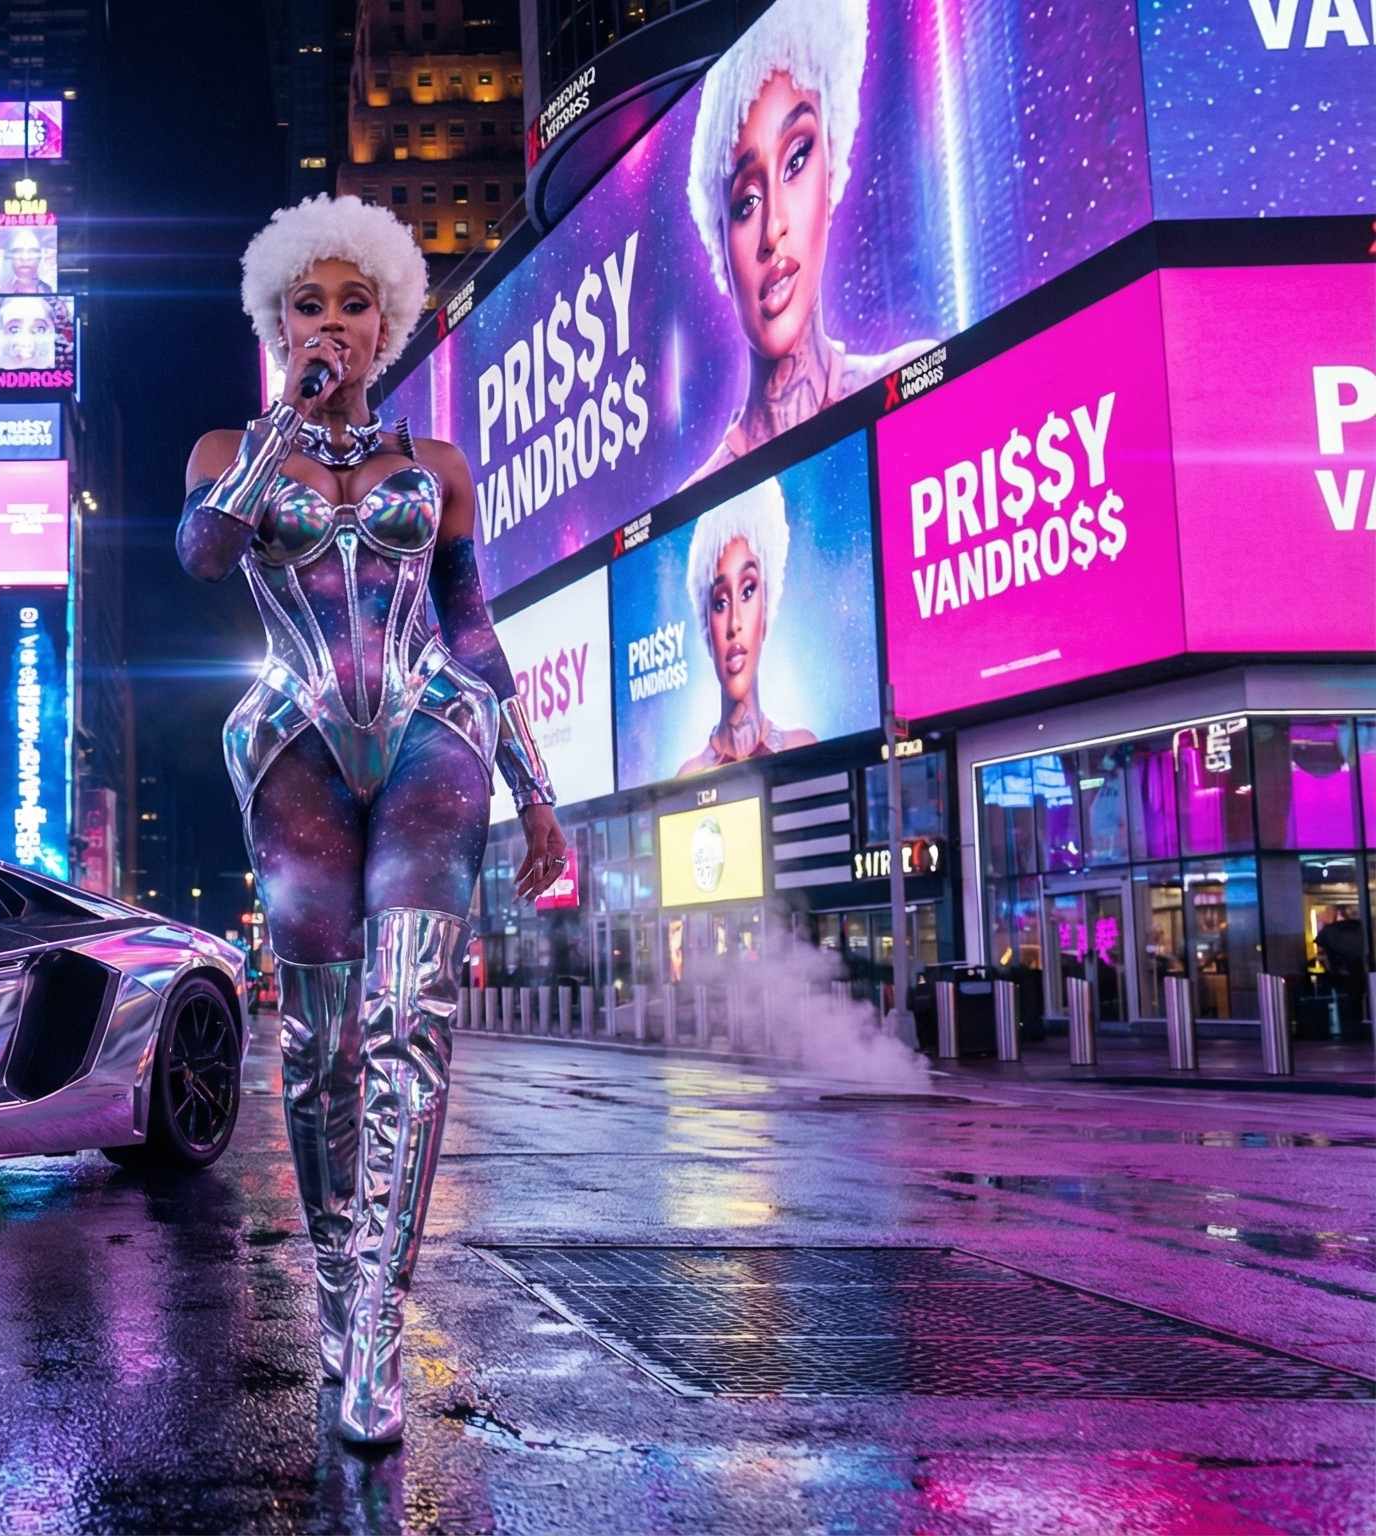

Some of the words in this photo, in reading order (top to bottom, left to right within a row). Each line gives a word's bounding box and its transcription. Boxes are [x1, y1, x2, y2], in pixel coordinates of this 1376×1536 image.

[479, 232, 639, 466] PRI$$Y
[476, 358, 649, 545] VANDRO$$
[910, 392, 1115, 558] PRI$$Y
[912, 489, 1128, 620] VANDRO$$
